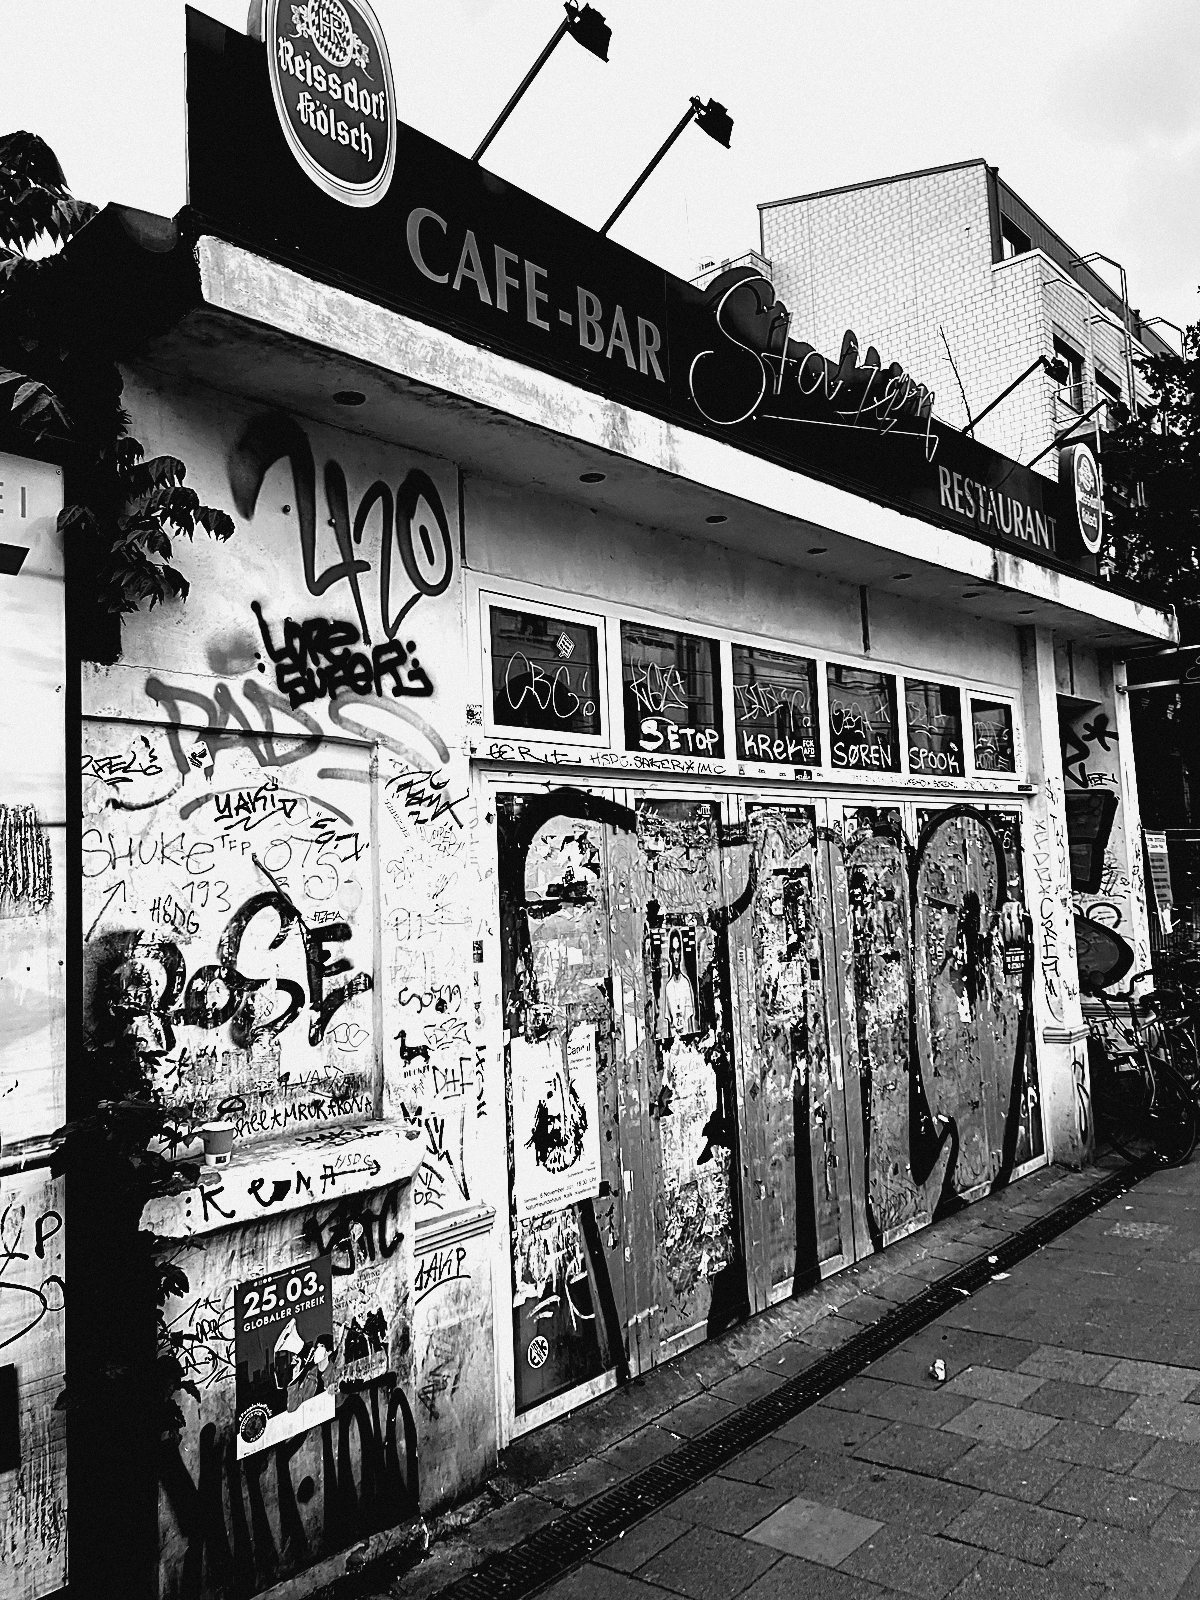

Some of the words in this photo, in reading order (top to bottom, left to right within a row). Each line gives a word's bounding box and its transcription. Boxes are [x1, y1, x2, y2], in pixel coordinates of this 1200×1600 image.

[277, 36, 386, 122] Reissdorf
[296, 91, 373, 162] Kölsch
[406, 207, 665, 383] CAFE-BAR
[938, 465, 1057, 552] RESTAURANT
[243, 1271, 325, 1320] 25.03.
[243, 1307, 292, 1332] GLOBALER
[294, 1295, 325, 1314] STREIK
